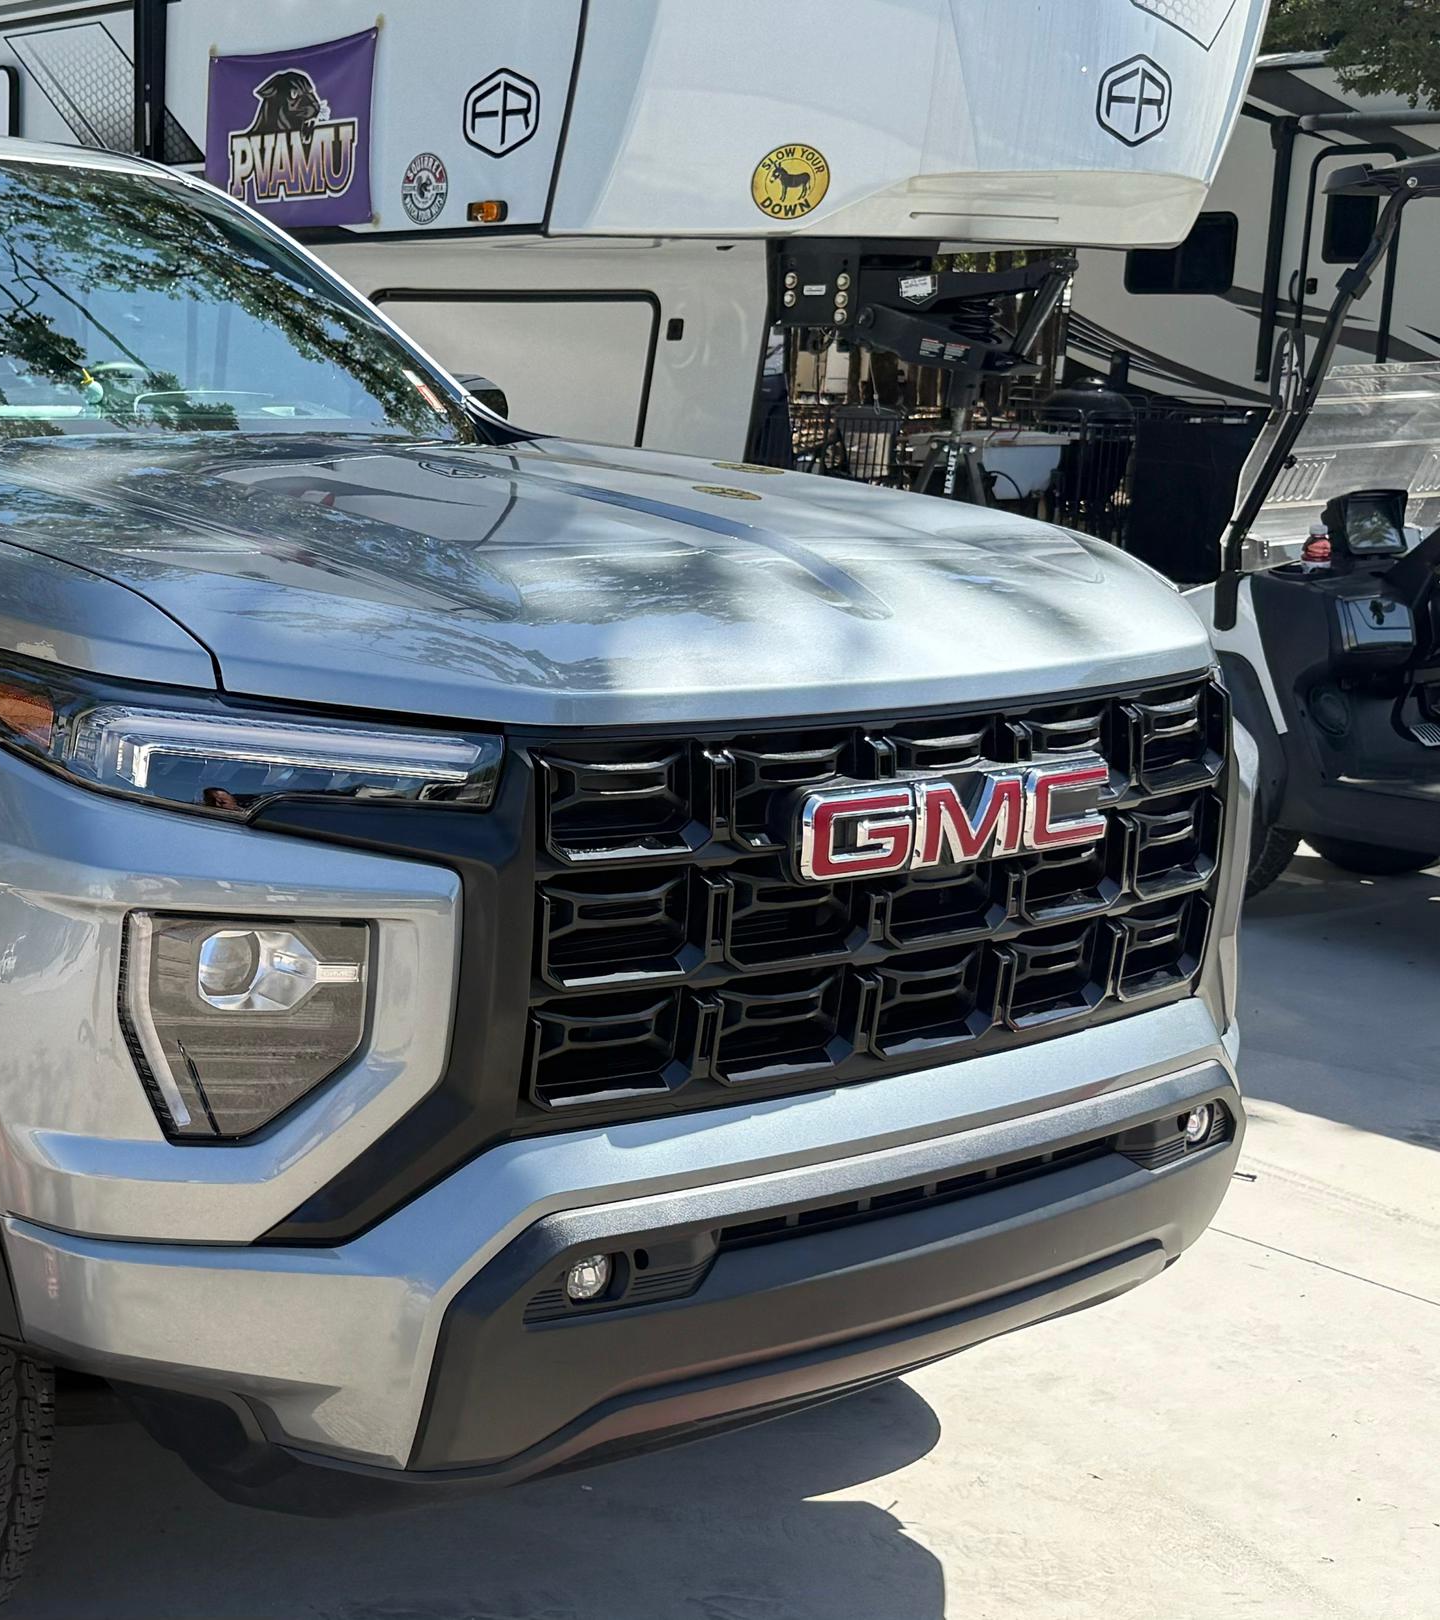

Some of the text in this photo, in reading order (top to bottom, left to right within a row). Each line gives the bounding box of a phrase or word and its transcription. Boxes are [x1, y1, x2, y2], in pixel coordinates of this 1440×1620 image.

[229, 119, 357, 203] PVAMU
[407, 156, 442, 180] SQUIRREL
[762, 147, 826, 174] SLOW YOUR
[760, 196, 812, 217] DOWN
[801, 755, 1108, 881] GMC
